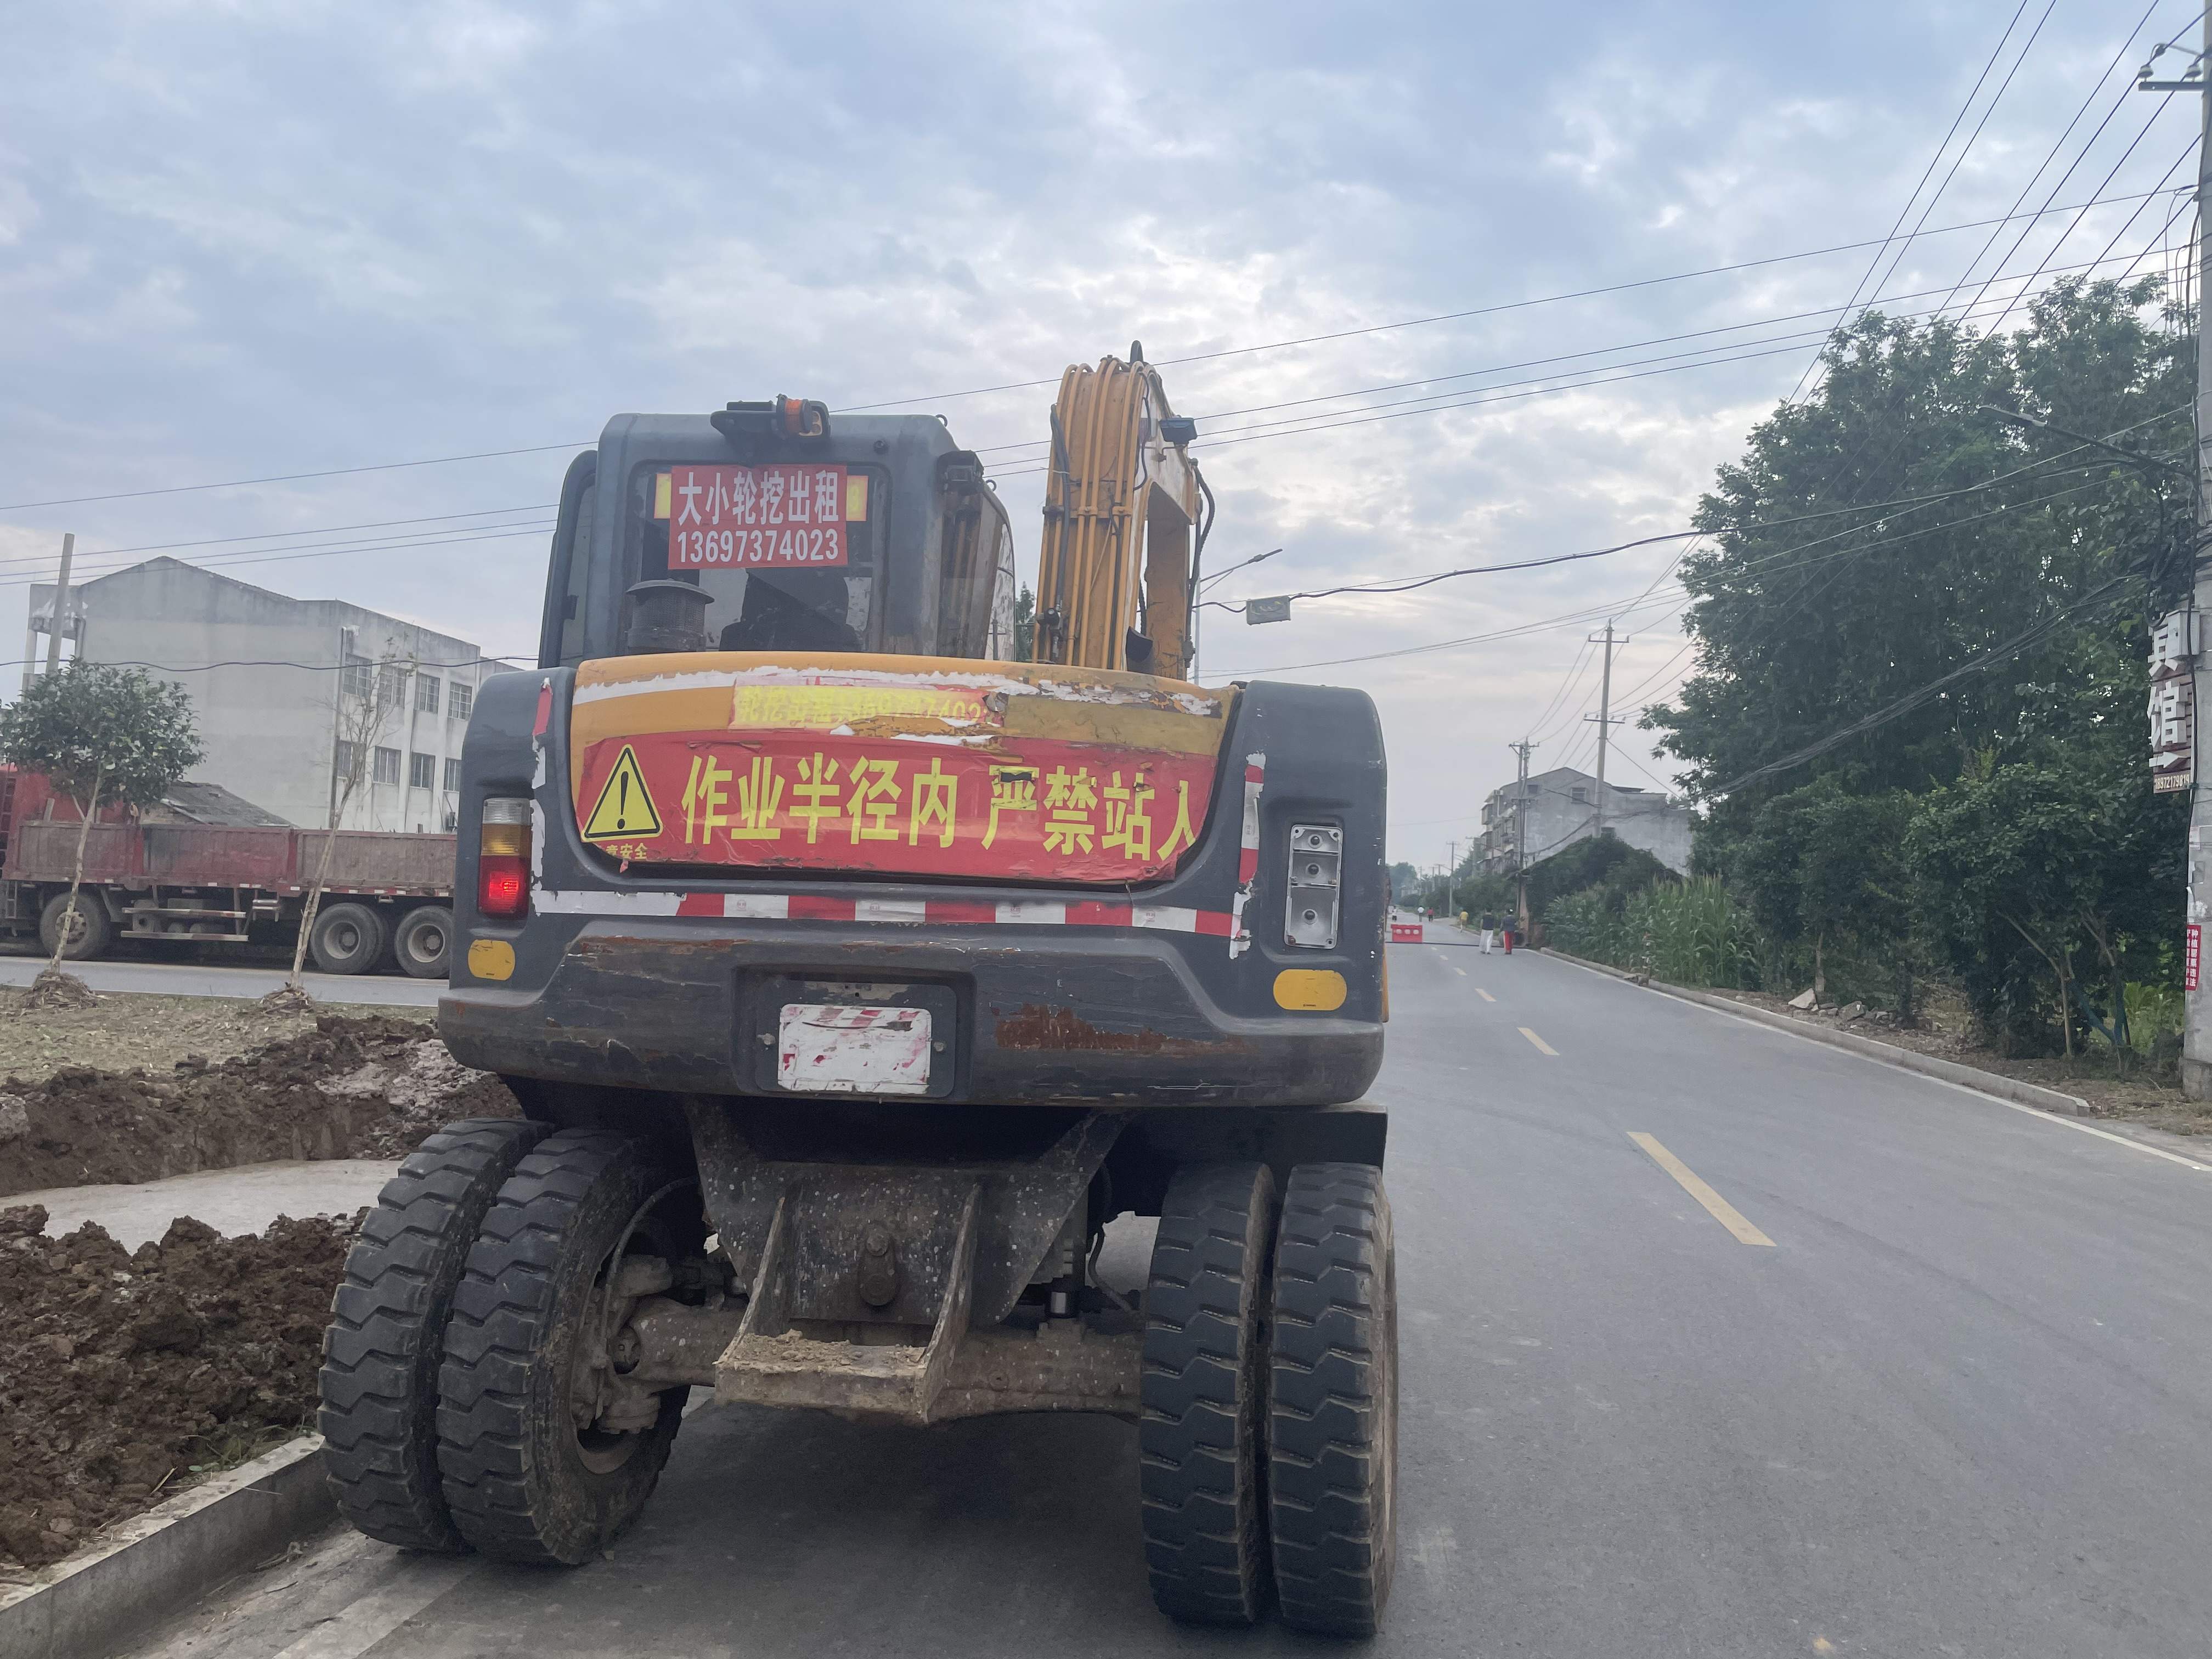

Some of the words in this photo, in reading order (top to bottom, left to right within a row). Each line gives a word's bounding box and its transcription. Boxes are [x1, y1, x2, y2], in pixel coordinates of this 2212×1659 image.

[678, 470, 839, 526] 大小轮挖出租
[678, 528, 839, 563] 13697374023
[681, 752, 958, 848] 作业半径内
[981, 765, 1197, 861] 严禁站人
